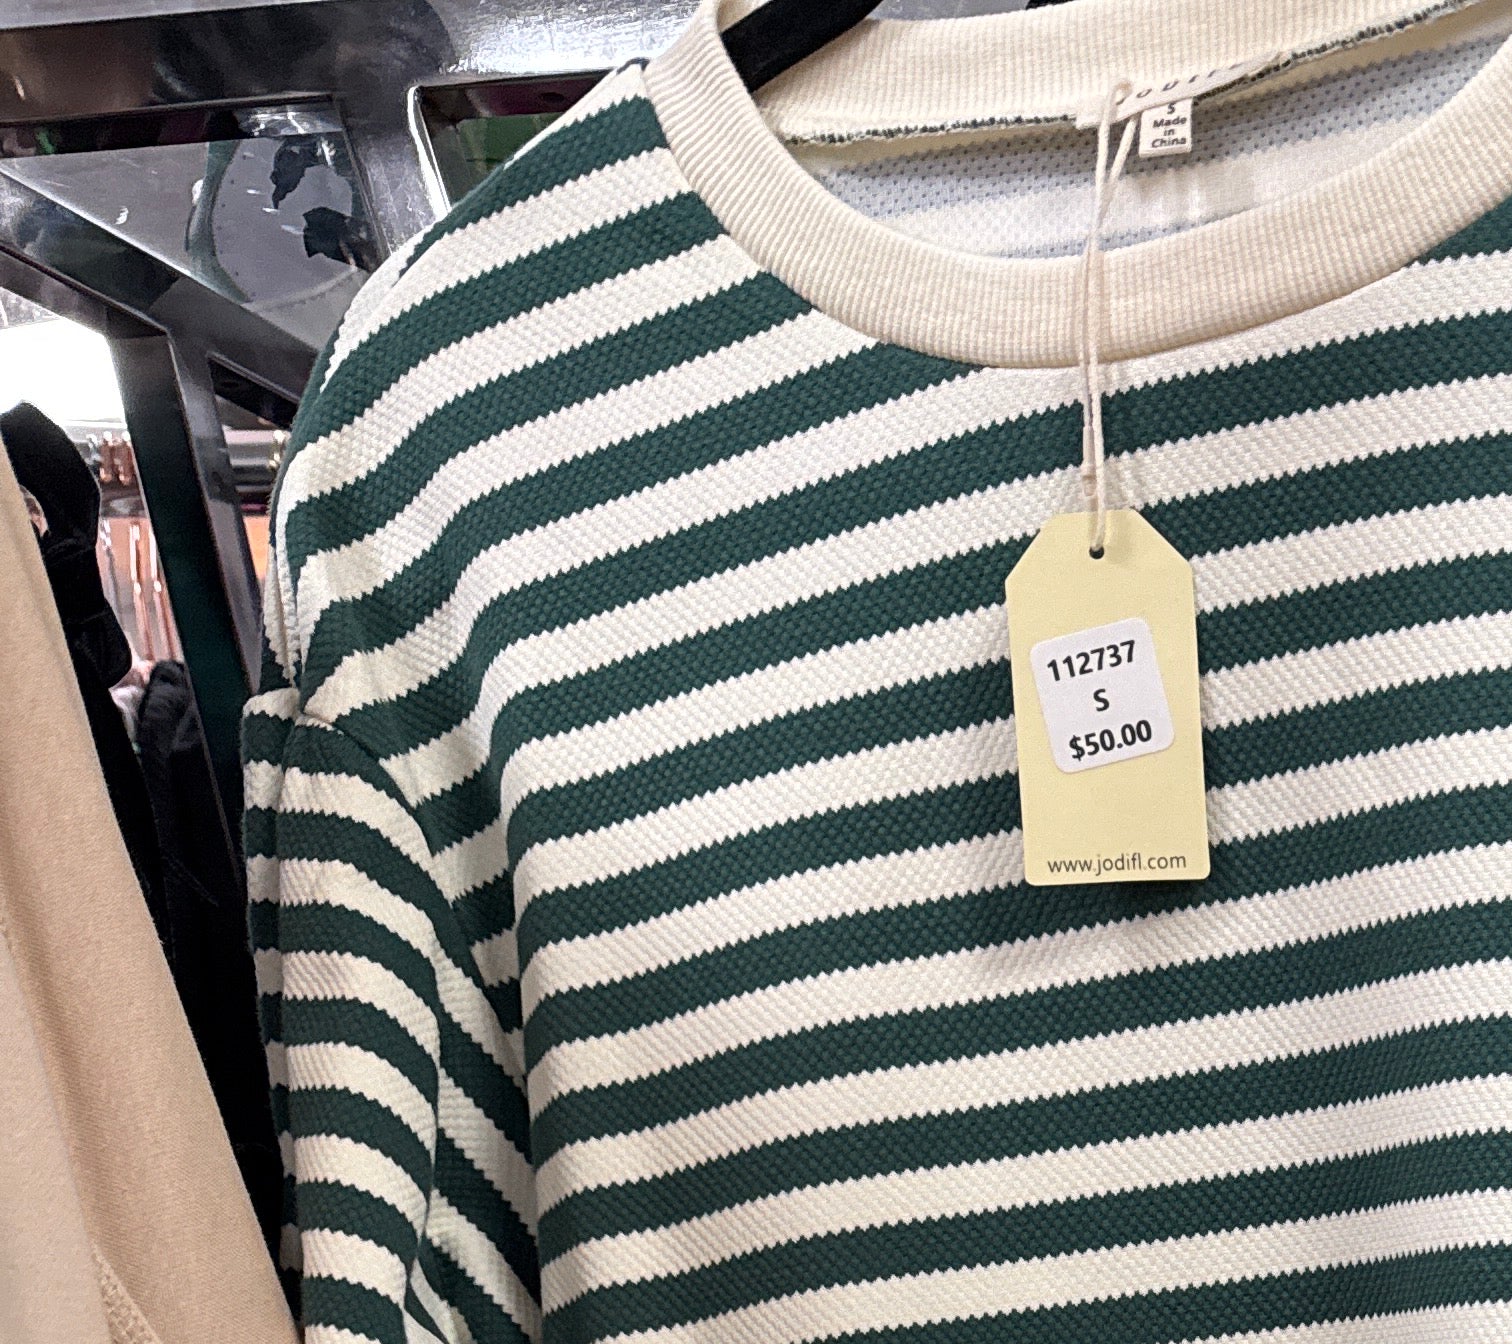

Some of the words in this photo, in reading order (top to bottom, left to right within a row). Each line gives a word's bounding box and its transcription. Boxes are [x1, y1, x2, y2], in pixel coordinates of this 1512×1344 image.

[1167, 103, 1175, 114] S
[1153, 116, 1187, 128] Made
[1163, 128, 1175, 136] in
[1151, 137, 1187, 148] China
[1047, 640, 1136, 682] 112737
[1093, 688, 1110, 712] S
[1068, 720, 1153, 761] $50.00
[1047, 852, 1187, 876] www.jodifl.com
